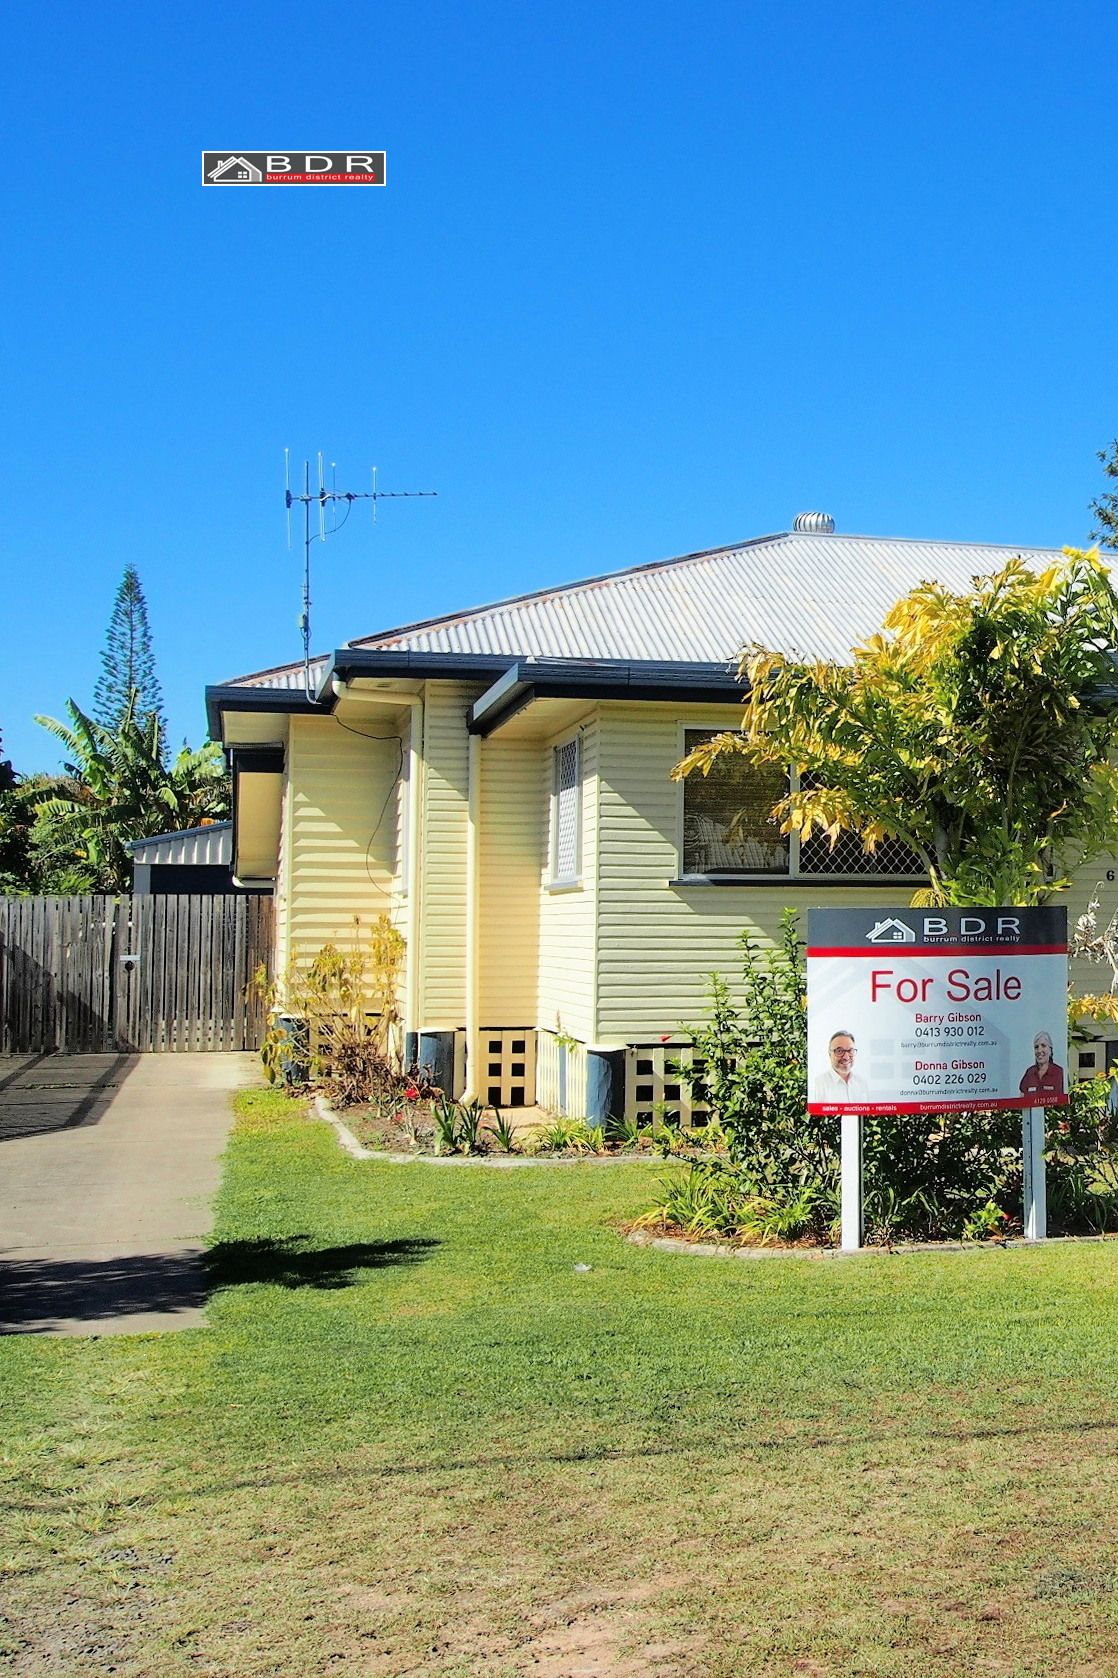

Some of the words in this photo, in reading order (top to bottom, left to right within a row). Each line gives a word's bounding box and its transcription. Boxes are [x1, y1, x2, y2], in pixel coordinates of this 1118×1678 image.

[1106, 870, 1115, 881] 6
[995, 935, 1021, 943] realty
[871, 970, 934, 1003] For
[946, 969, 1022, 1002] Sale
[915, 1013, 945, 1026] Barry
[947, 1012, 982, 1023] Gibson
[915, 1027, 941, 1037] 0413
[944, 1026, 964, 1037] 930
[967, 1026, 985, 1036] 012
[915, 1061, 948, 1071] Donna
[951, 1059, 985, 1070] Gibson
[912, 1074, 941, 1085] 0402
[944, 1073, 964, 1084] 226
[967, 1072, 987, 1083] 029
[843, 1104, 870, 1112] auctions
